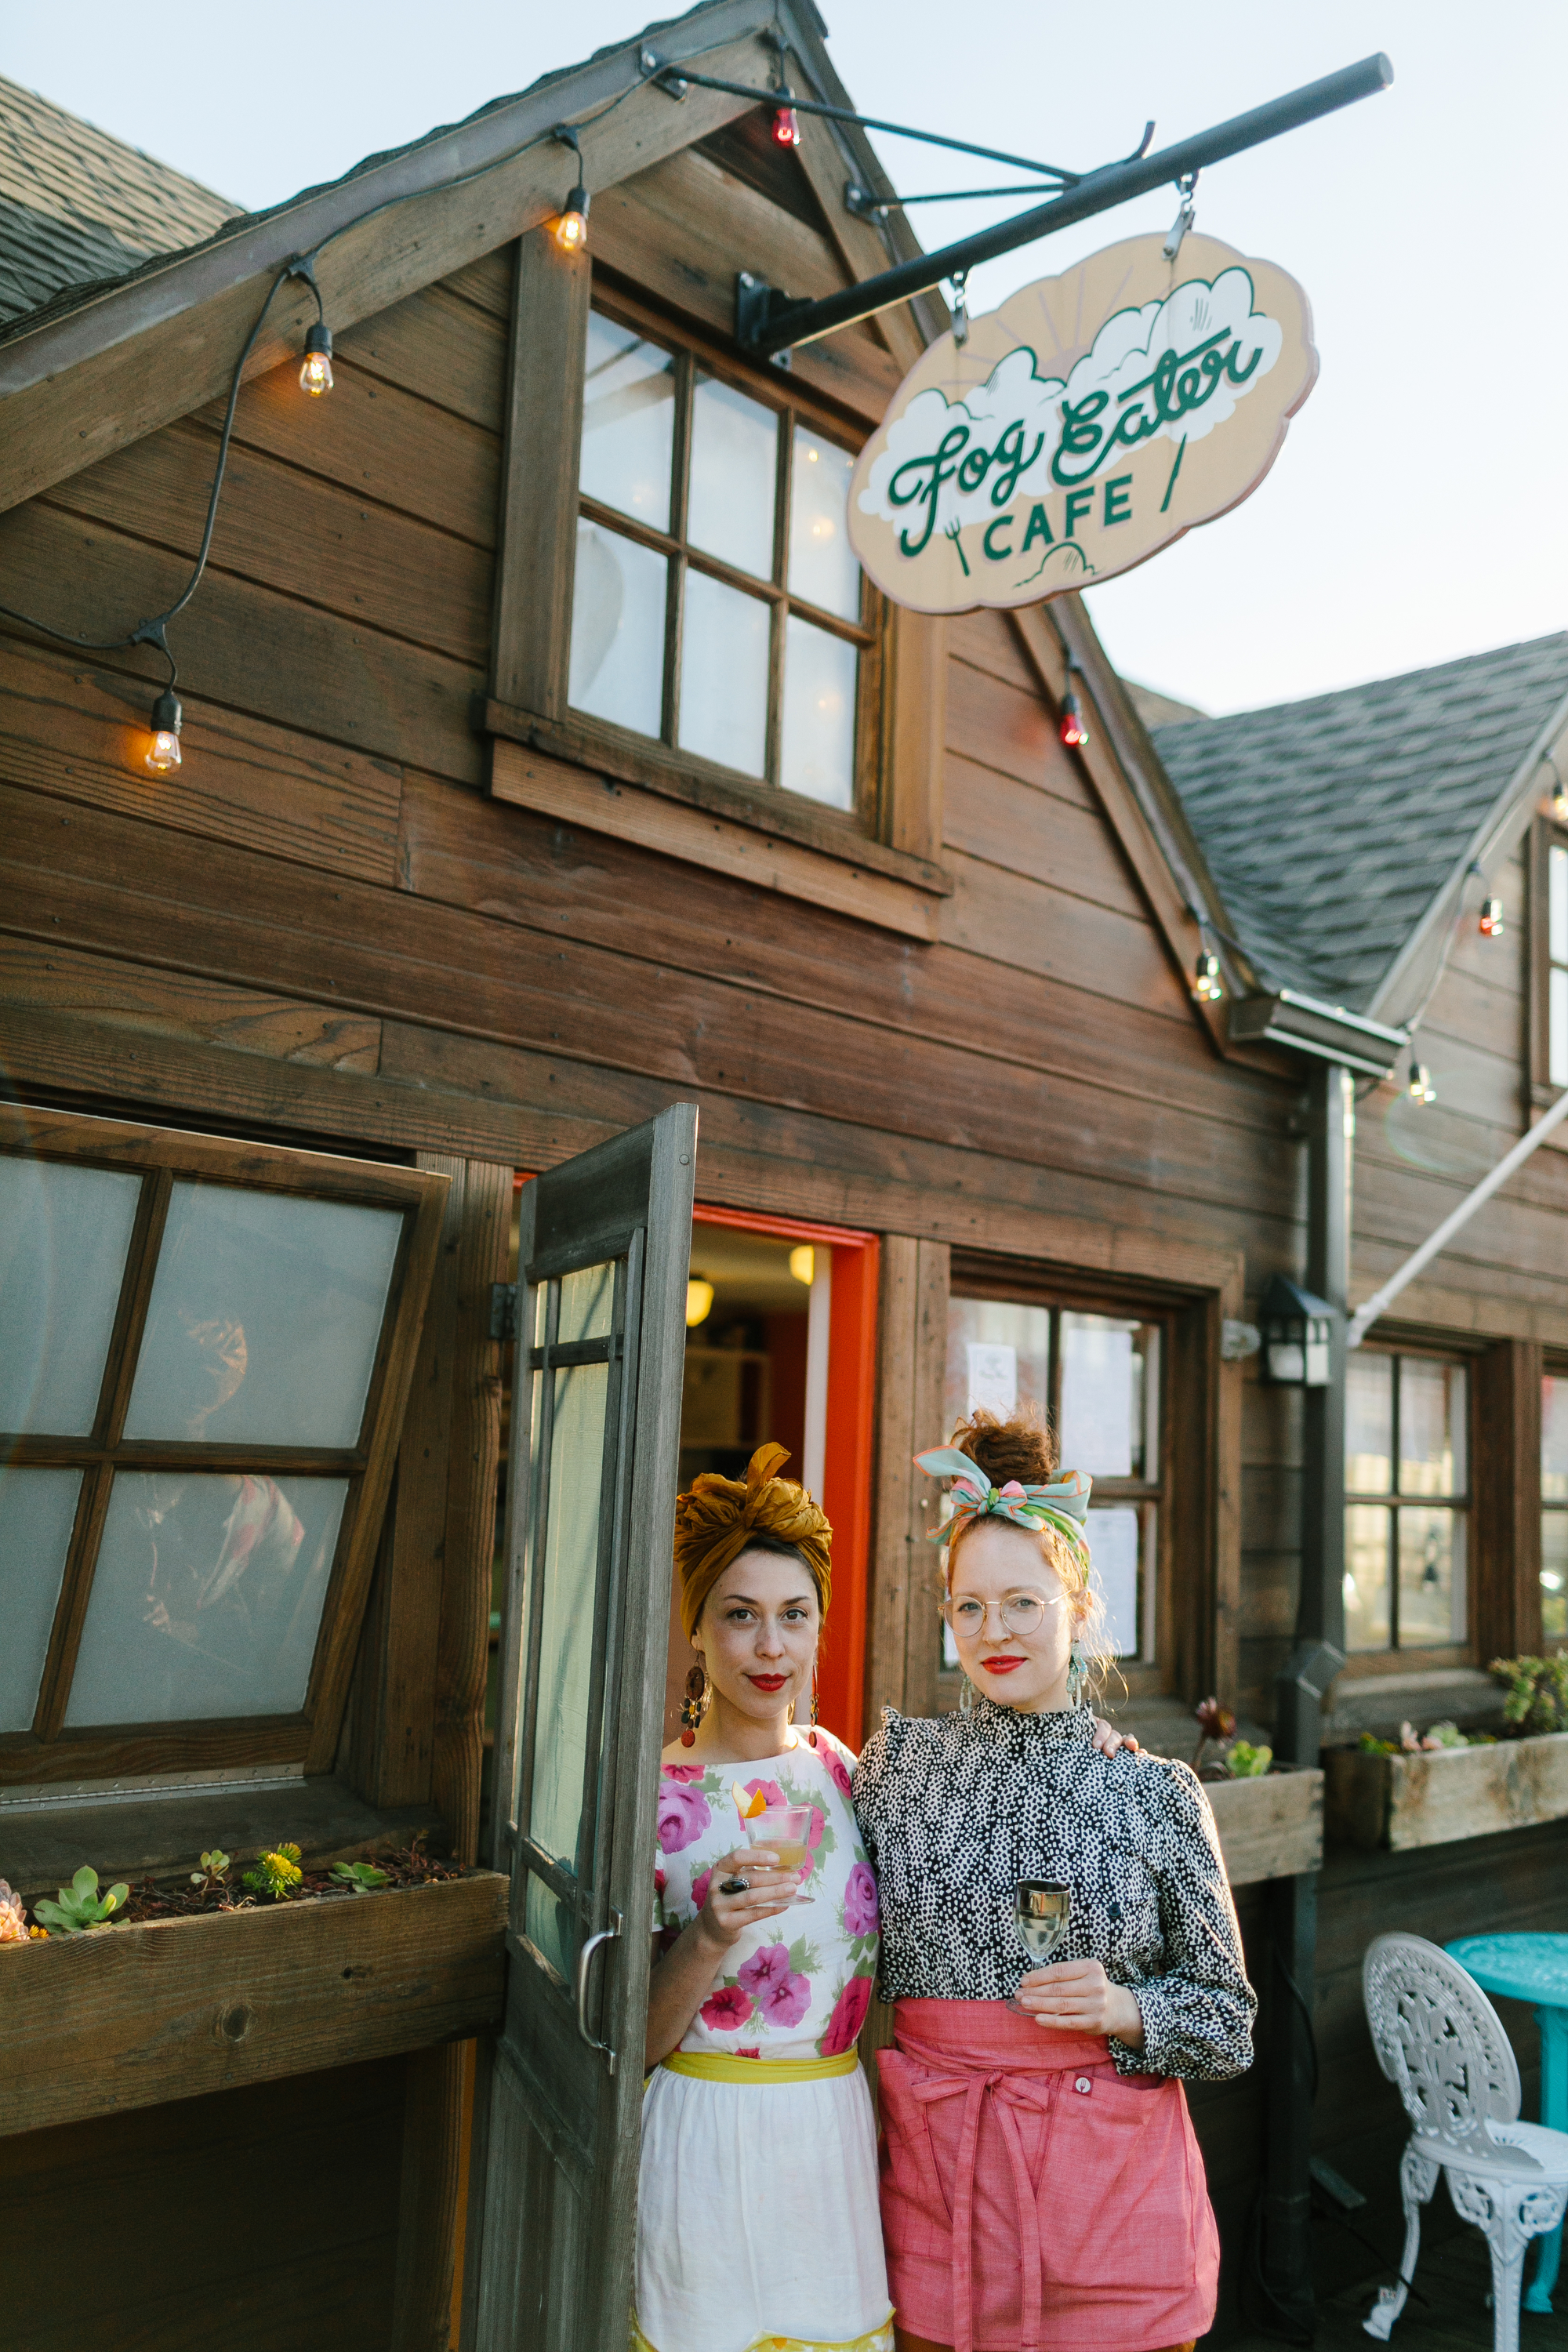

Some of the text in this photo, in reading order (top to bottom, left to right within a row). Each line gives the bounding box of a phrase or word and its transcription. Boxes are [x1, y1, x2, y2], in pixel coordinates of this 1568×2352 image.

[888, 327, 1264, 557] Fog Eater
[983, 474, 1134, 560] CAFE
